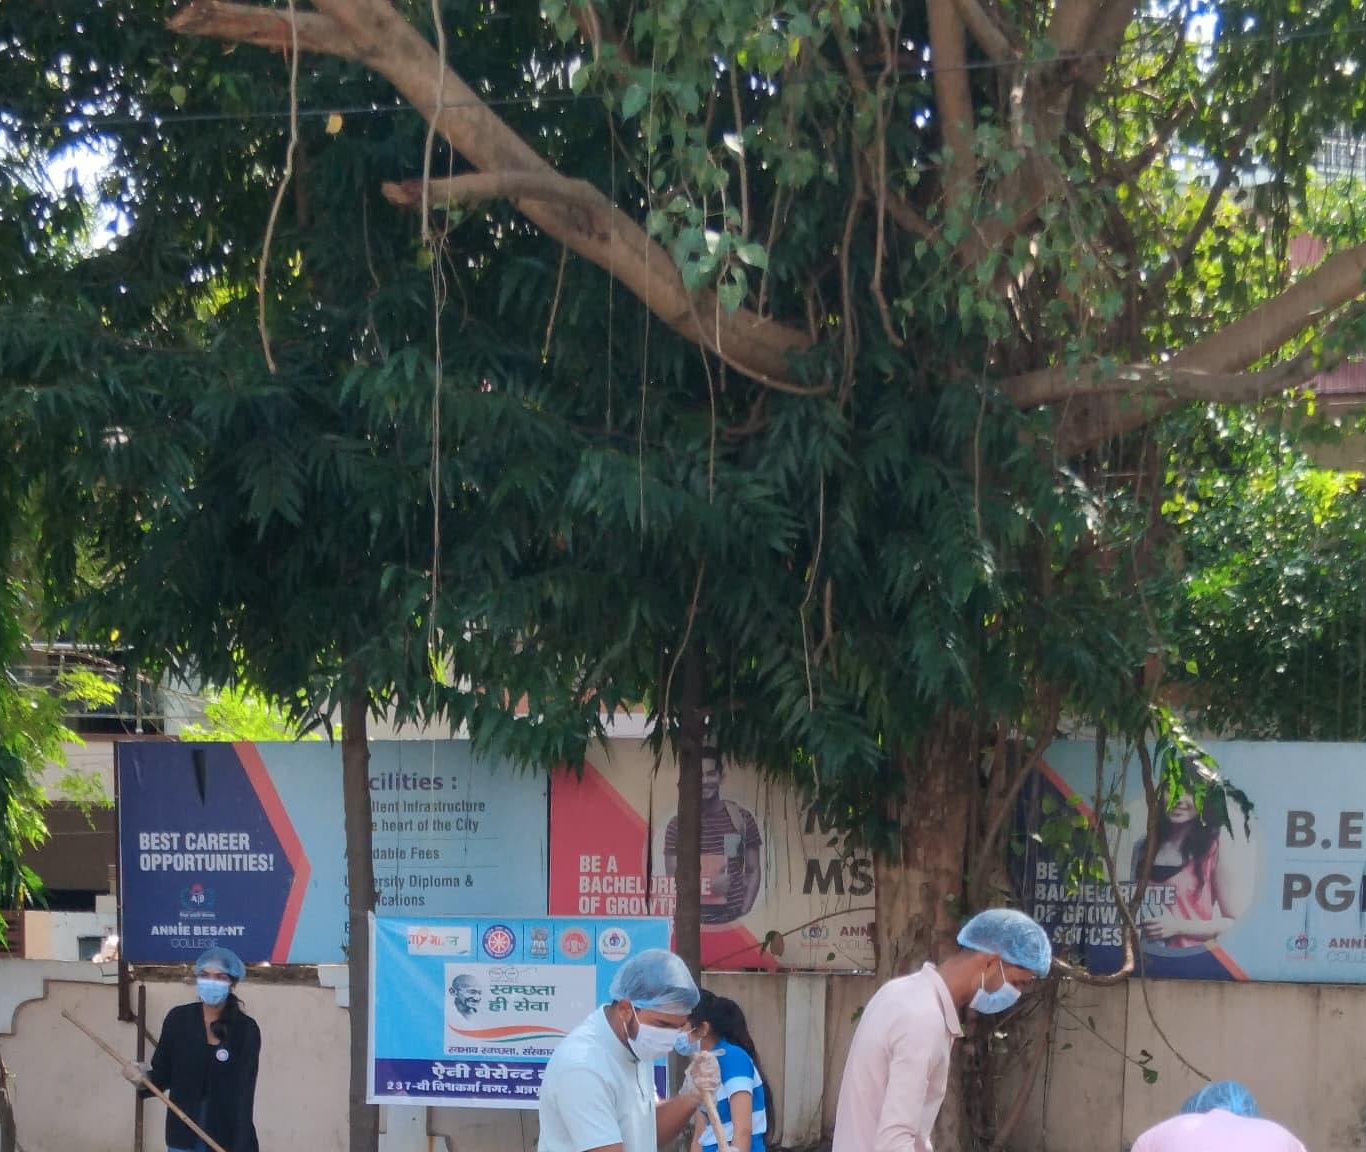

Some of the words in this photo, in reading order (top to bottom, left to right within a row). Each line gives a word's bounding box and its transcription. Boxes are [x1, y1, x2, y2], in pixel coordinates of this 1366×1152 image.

[370, 773, 444, 791] cilities
[403, 800, 486, 813] Infrastructure
[382, 819, 413, 832] heart
[417, 819, 429, 832] of
[432, 819, 452, 832] the
[455, 818, 479, 833] City
[139, 832, 181, 850] BEST
[185, 832, 250, 850] CAREER
[411, 847, 440, 859] Fees
[140, 853, 274, 871] OPPORTUNITIES!
[579, 855, 601, 872] BE
[606, 855, 618, 873] A
[1035, 862, 1059, 880] BE
[409, 875, 460, 889] Diploma
[465, 875, 474, 887] &
[578, 896, 600, 914] OF
[193, 925, 245, 936] BESANT
[171, 938, 219, 949] COLLEGE
[489, 984, 556, 996] स्वच्छता
[488, 996, 508, 1012] ही
[513, 997, 550, 1012] सेवा
[432, 1062, 471, 1080] ऐनी
